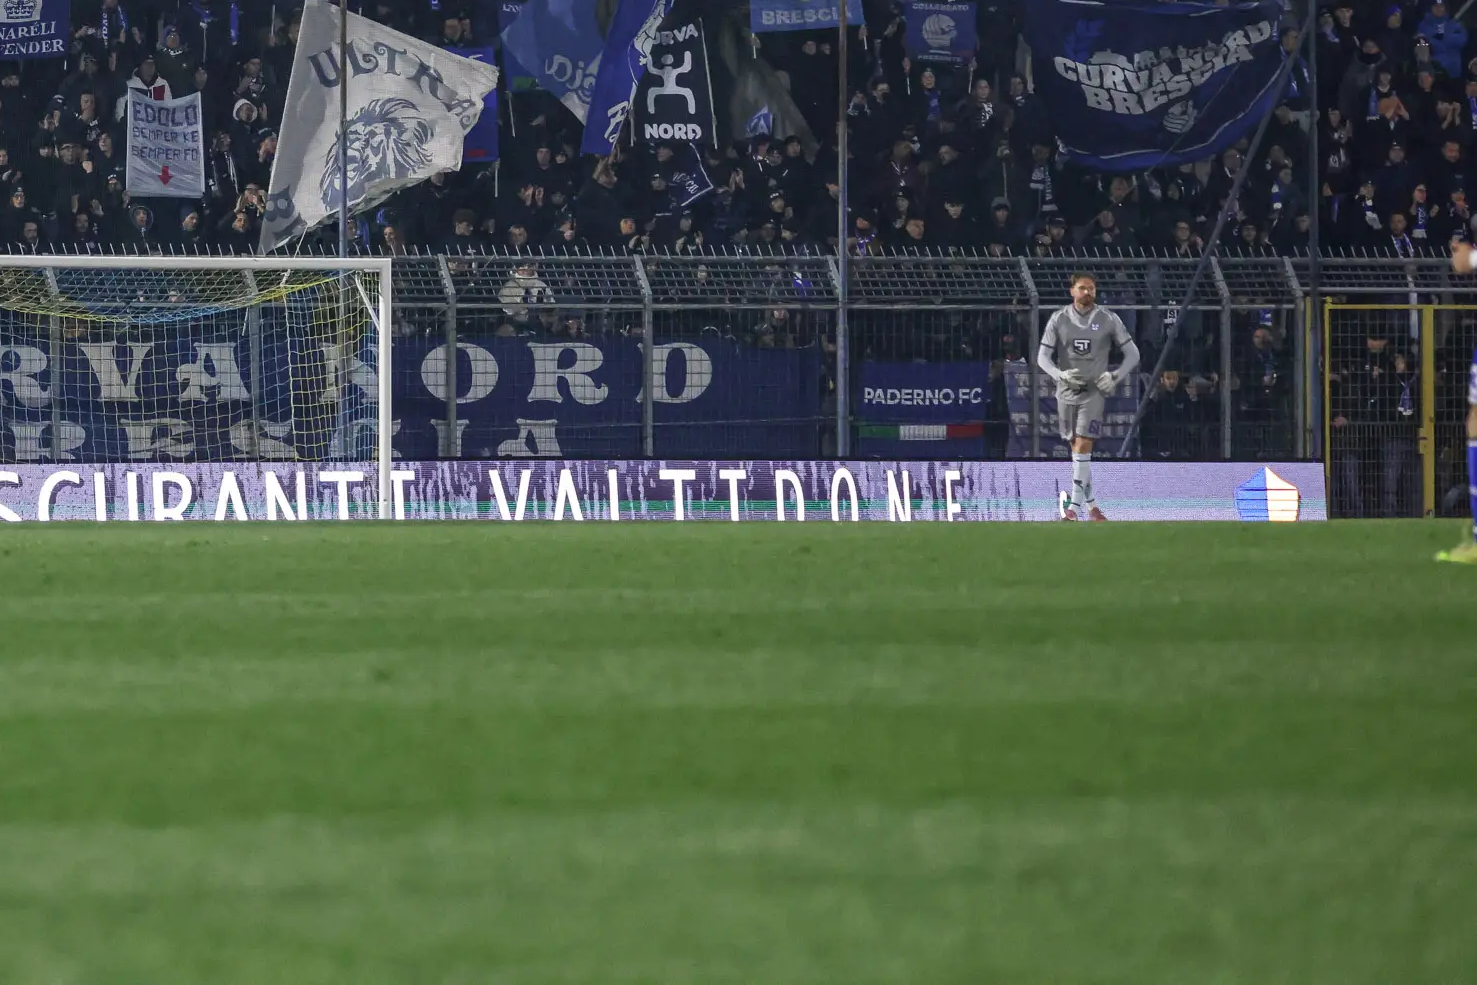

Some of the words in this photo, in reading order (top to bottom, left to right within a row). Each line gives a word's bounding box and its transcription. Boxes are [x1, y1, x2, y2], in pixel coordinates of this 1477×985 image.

[652, 23, 699, 46] URVA
[1053, 56, 1174, 93] CURVA
[132, 101, 198, 127] EDOLO
[644, 122, 702, 140] NORD
[319, 341, 713, 405] NORD
[864, 387, 955, 406] PADERNO
[958, 387, 983, 405] FC
